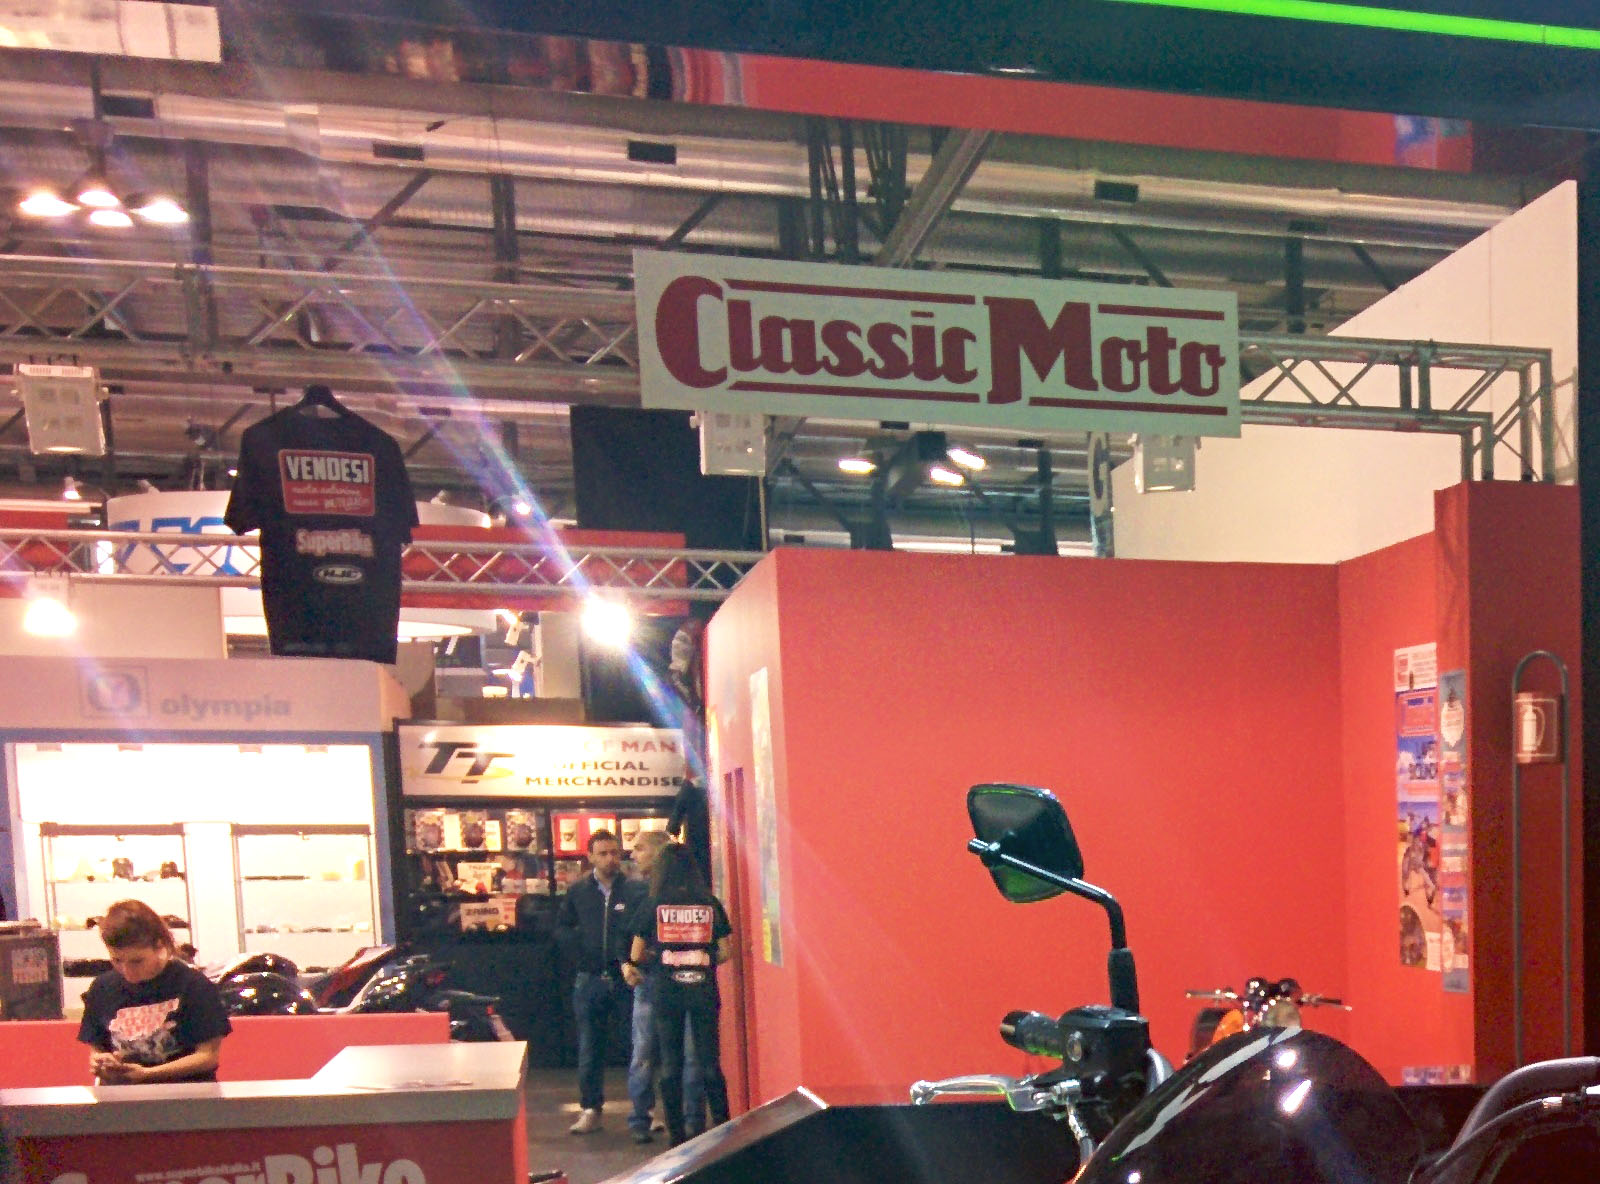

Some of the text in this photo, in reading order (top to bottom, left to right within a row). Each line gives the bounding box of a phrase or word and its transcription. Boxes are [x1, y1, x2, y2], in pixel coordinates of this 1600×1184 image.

[656, 275, 1227, 405] Classic Moto
[285, 455, 370, 485] VENDESI
[160, 693, 291, 722] olympia
[620, 740, 678, 753] MAN
[525, 775, 685, 787] MERCHANDISE
[661, 909, 710, 923] VENDESI
